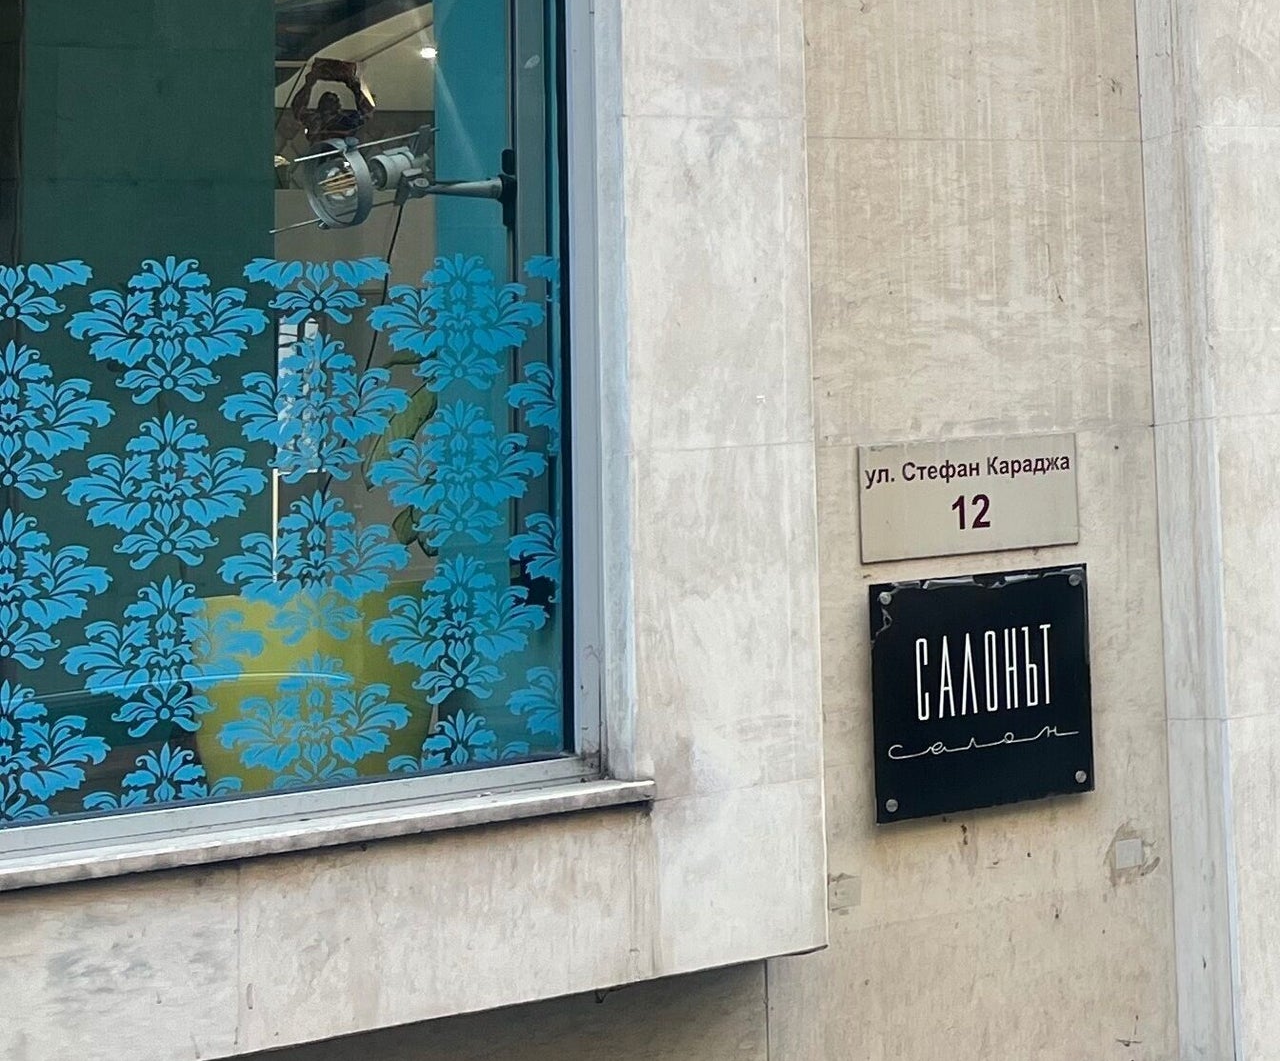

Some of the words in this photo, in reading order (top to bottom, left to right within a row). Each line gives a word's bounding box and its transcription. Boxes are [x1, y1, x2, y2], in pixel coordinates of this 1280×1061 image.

[864, 468, 895, 489] ул.
[902, 460, 980, 483] Стефан
[986, 455, 1070, 478] Караджа
[951, 493, 991, 530] 12
[915, 624, 1051, 721] САЛОНЪТ
